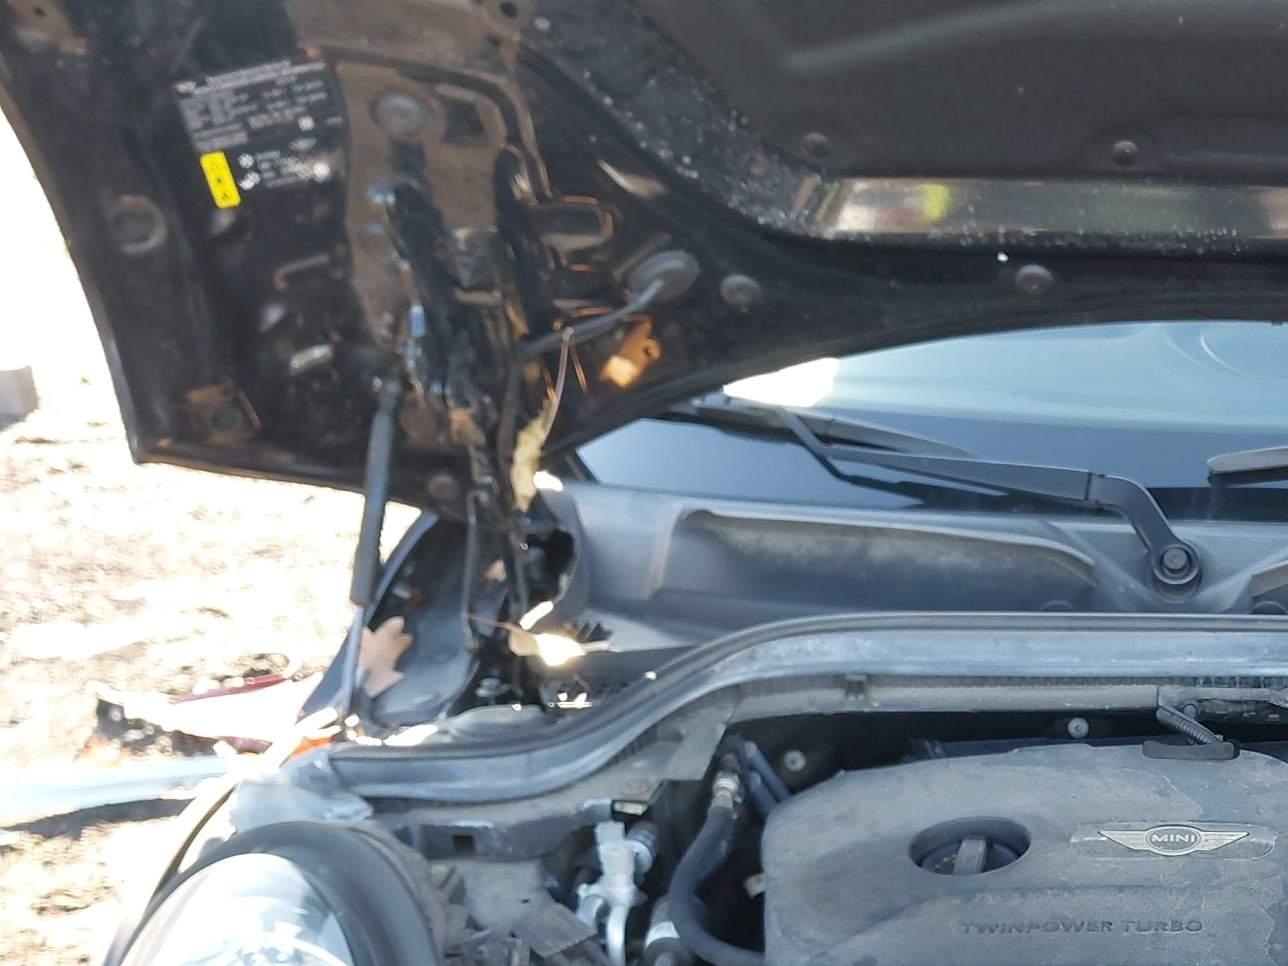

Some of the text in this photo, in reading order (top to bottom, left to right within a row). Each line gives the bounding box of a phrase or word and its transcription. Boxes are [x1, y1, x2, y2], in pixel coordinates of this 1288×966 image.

[1151, 833, 1196, 843] MINI
[960, 919, 1203, 935] TWINPOWER TURBO
